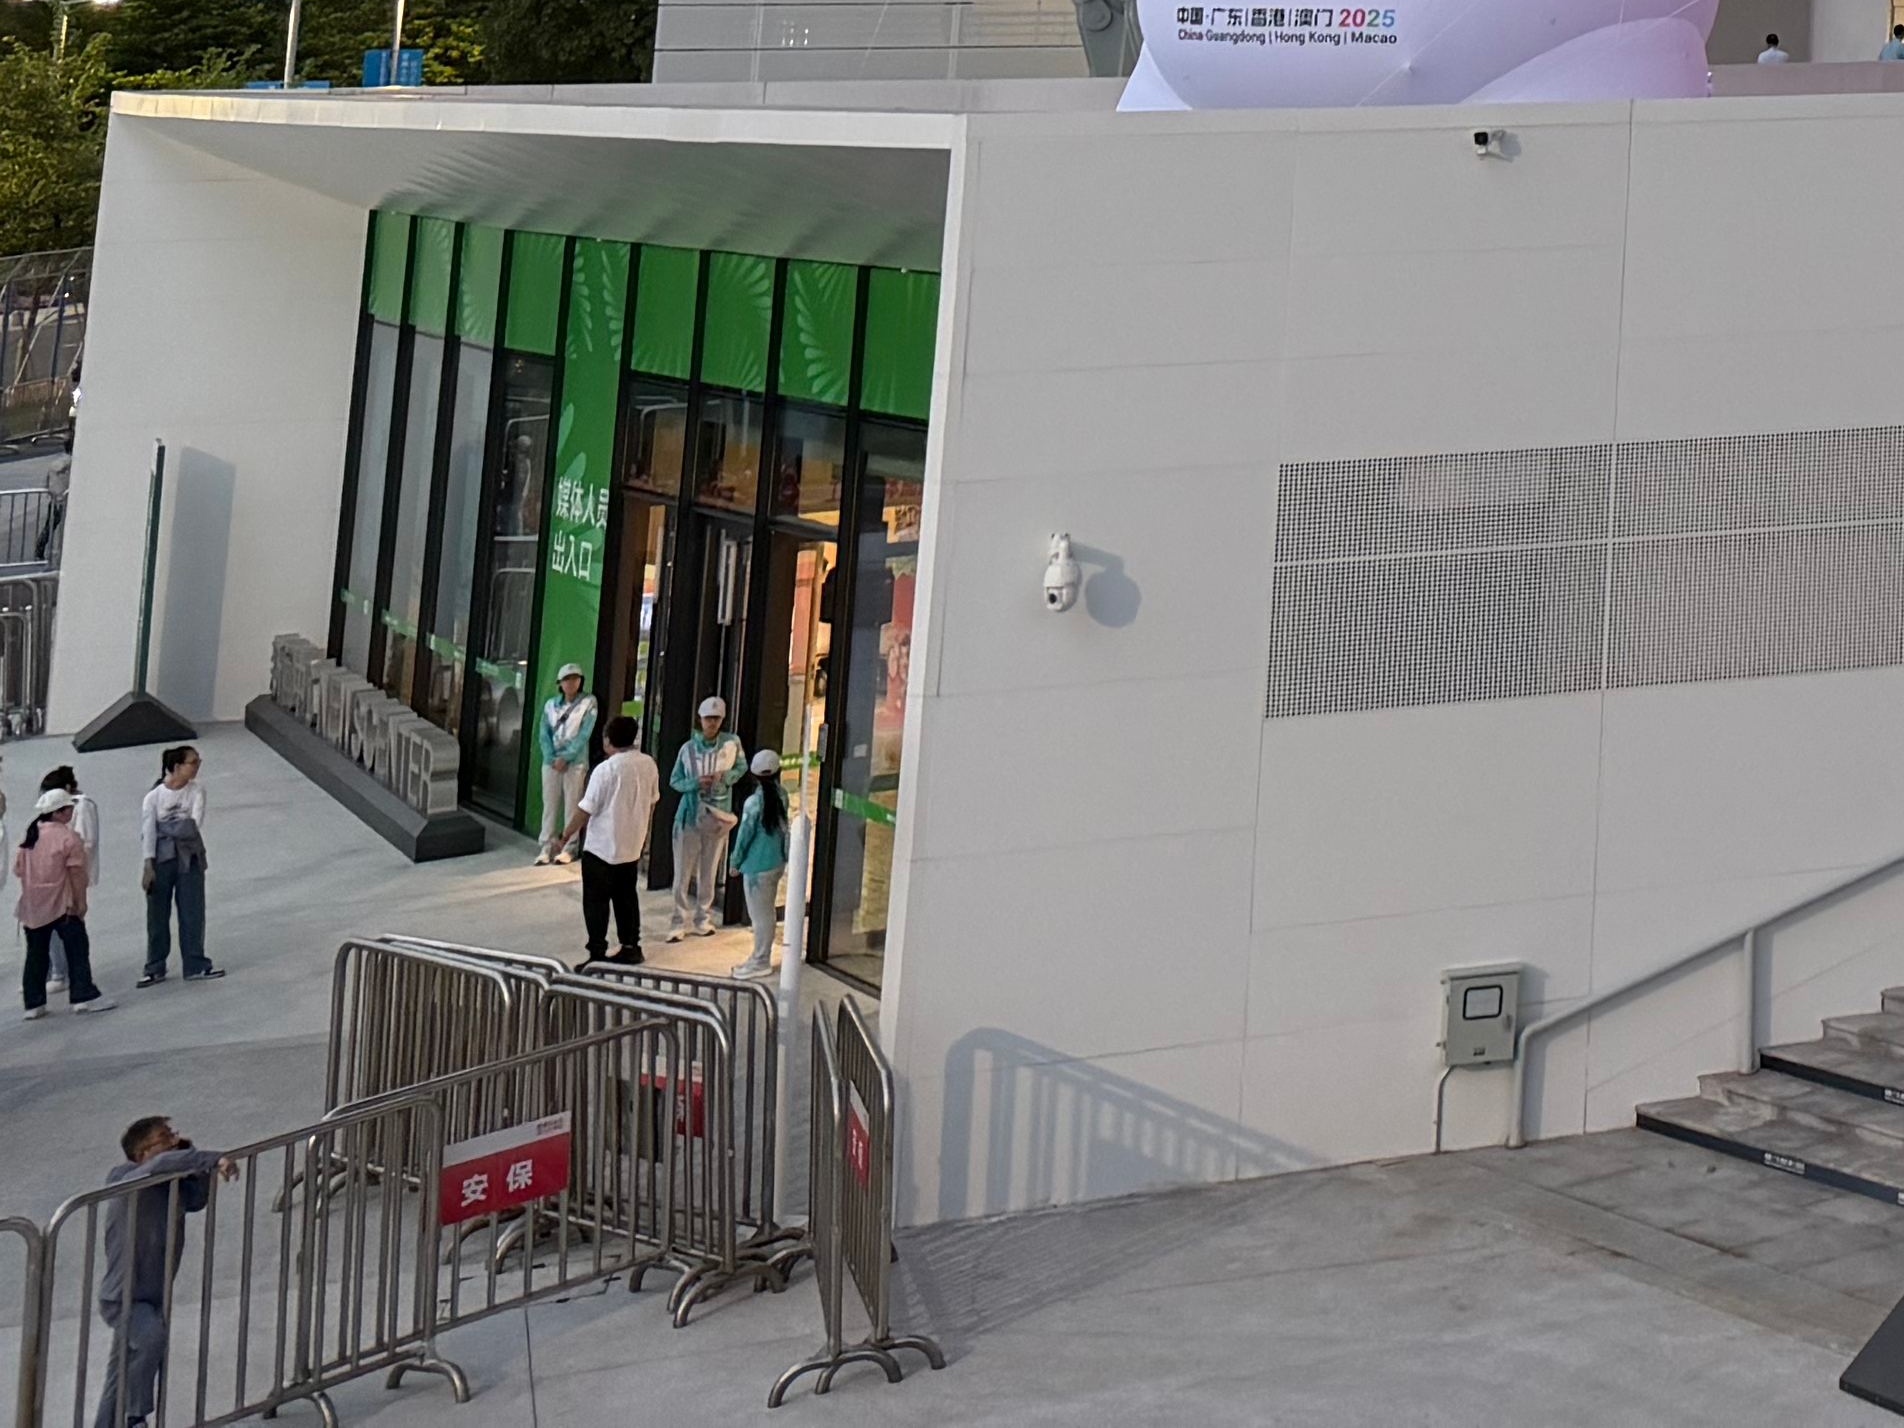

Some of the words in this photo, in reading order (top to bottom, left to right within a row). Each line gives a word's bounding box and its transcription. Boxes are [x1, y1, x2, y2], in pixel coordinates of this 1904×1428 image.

[1338, 8, 1396, 28] 2025
[1274, 29, 1306, 46] Hong
[1309, 30, 1341, 46] Kong
[1351, 31, 1397, 44] Macao
[552, 530, 592, 581] 出入口
